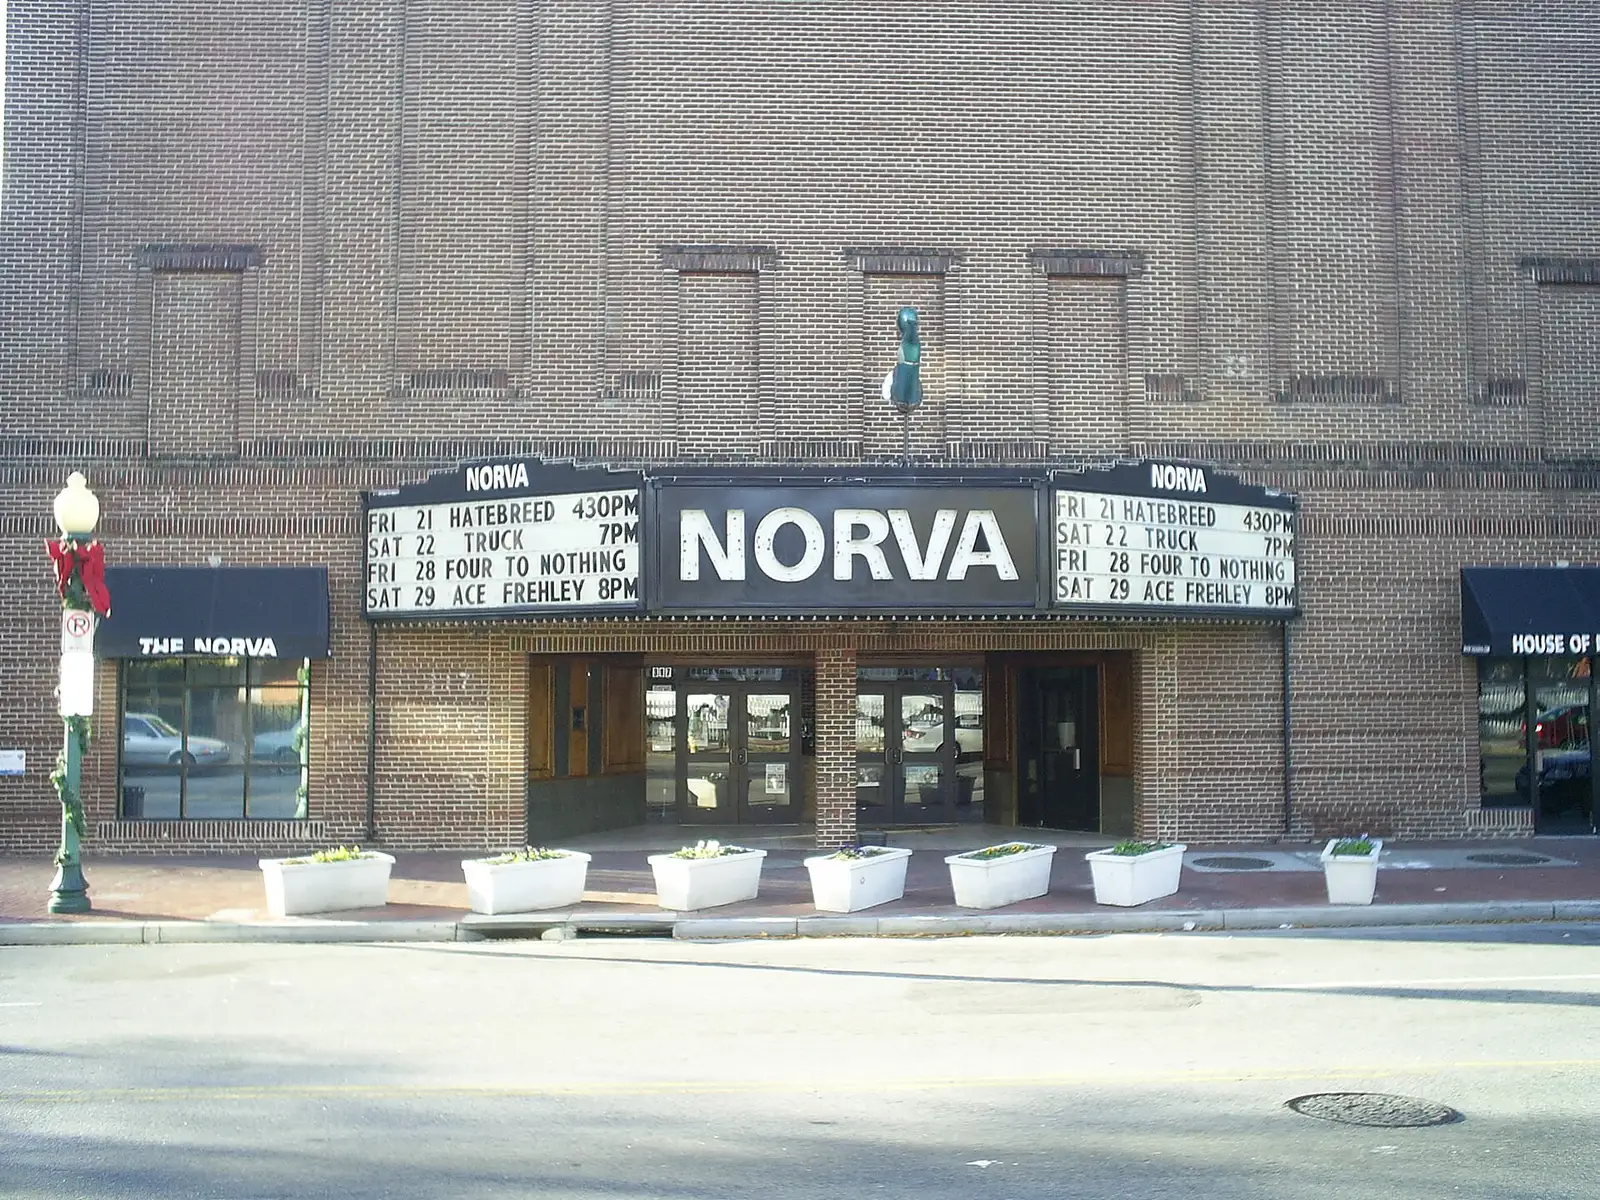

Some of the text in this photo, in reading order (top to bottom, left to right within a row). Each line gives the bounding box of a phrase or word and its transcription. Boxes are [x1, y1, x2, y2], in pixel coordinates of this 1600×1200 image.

[466, 462, 530, 492] NORVA
[1151, 463, 1208, 493] NORVA
[368, 495, 639, 534] FRI 21 HATEBREED 430PM
[1057, 495, 1295, 534] FRI 21 HATEBREED 430PM
[368, 522, 639, 559] SAT 22 TRUCK 7PM
[680, 506, 1020, 583] NORVA
[1057, 522, 1295, 558] SAT 22 TRUCK 7PM
[368, 549, 627, 584] FRI 28 FOUR TO NOTHING
[1057, 549, 1286, 581] FRI 28 FOUR TO NOTHING
[367, 577, 639, 609] SAT 29 ACE FREHLEY 8PM
[1058, 576, 1296, 607] SAT 29 ACE FREHLEY 8PM
[139, 637, 278, 657] THE NORVA
[1512, 633, 1565, 654] HOUSE
[1569, 633, 1590, 654] OF
